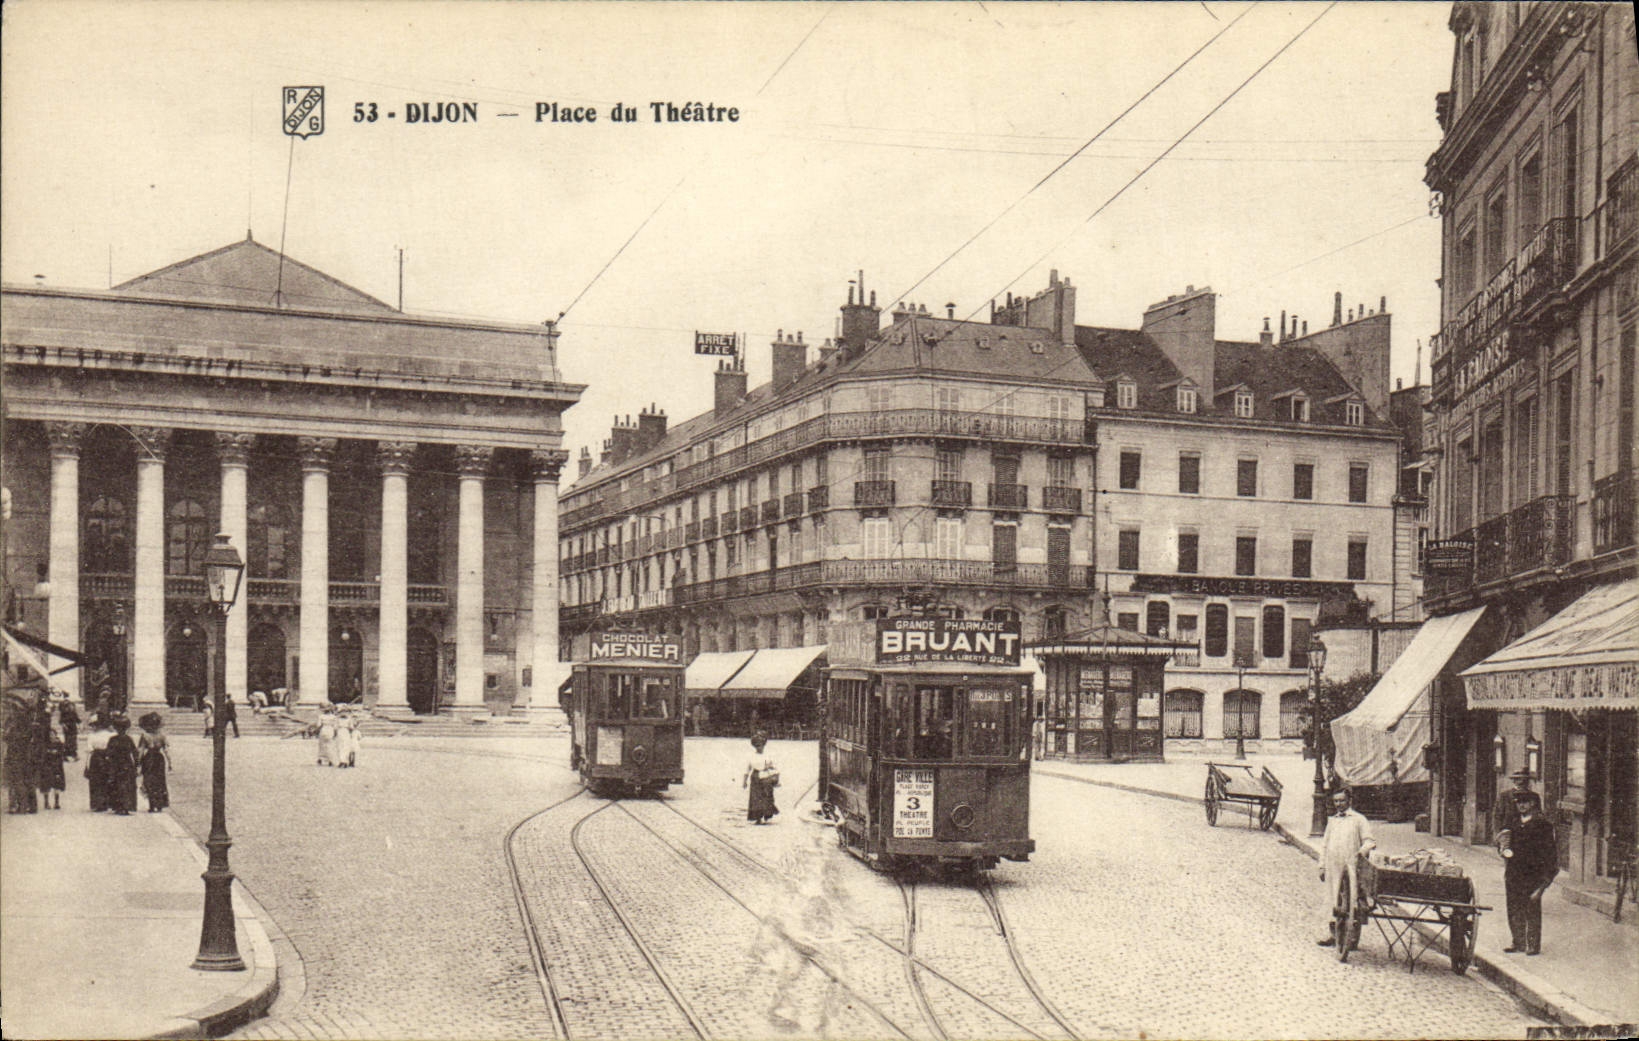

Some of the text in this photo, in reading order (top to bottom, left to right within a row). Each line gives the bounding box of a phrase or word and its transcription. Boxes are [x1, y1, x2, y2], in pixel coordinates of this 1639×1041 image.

[698, 335, 734, 346] ARRET
[700, 345, 730, 354] FIXE
[896, 620, 1005, 632] GRANDE PHARMACIE
[602, 634, 669, 643] CHOCOLAT
[882, 631, 1019, 656] BRUANT
[592, 643, 678, 660] MENIER
[896, 771, 932, 783] GARE VILLE
[907, 797, 920, 810] 3
